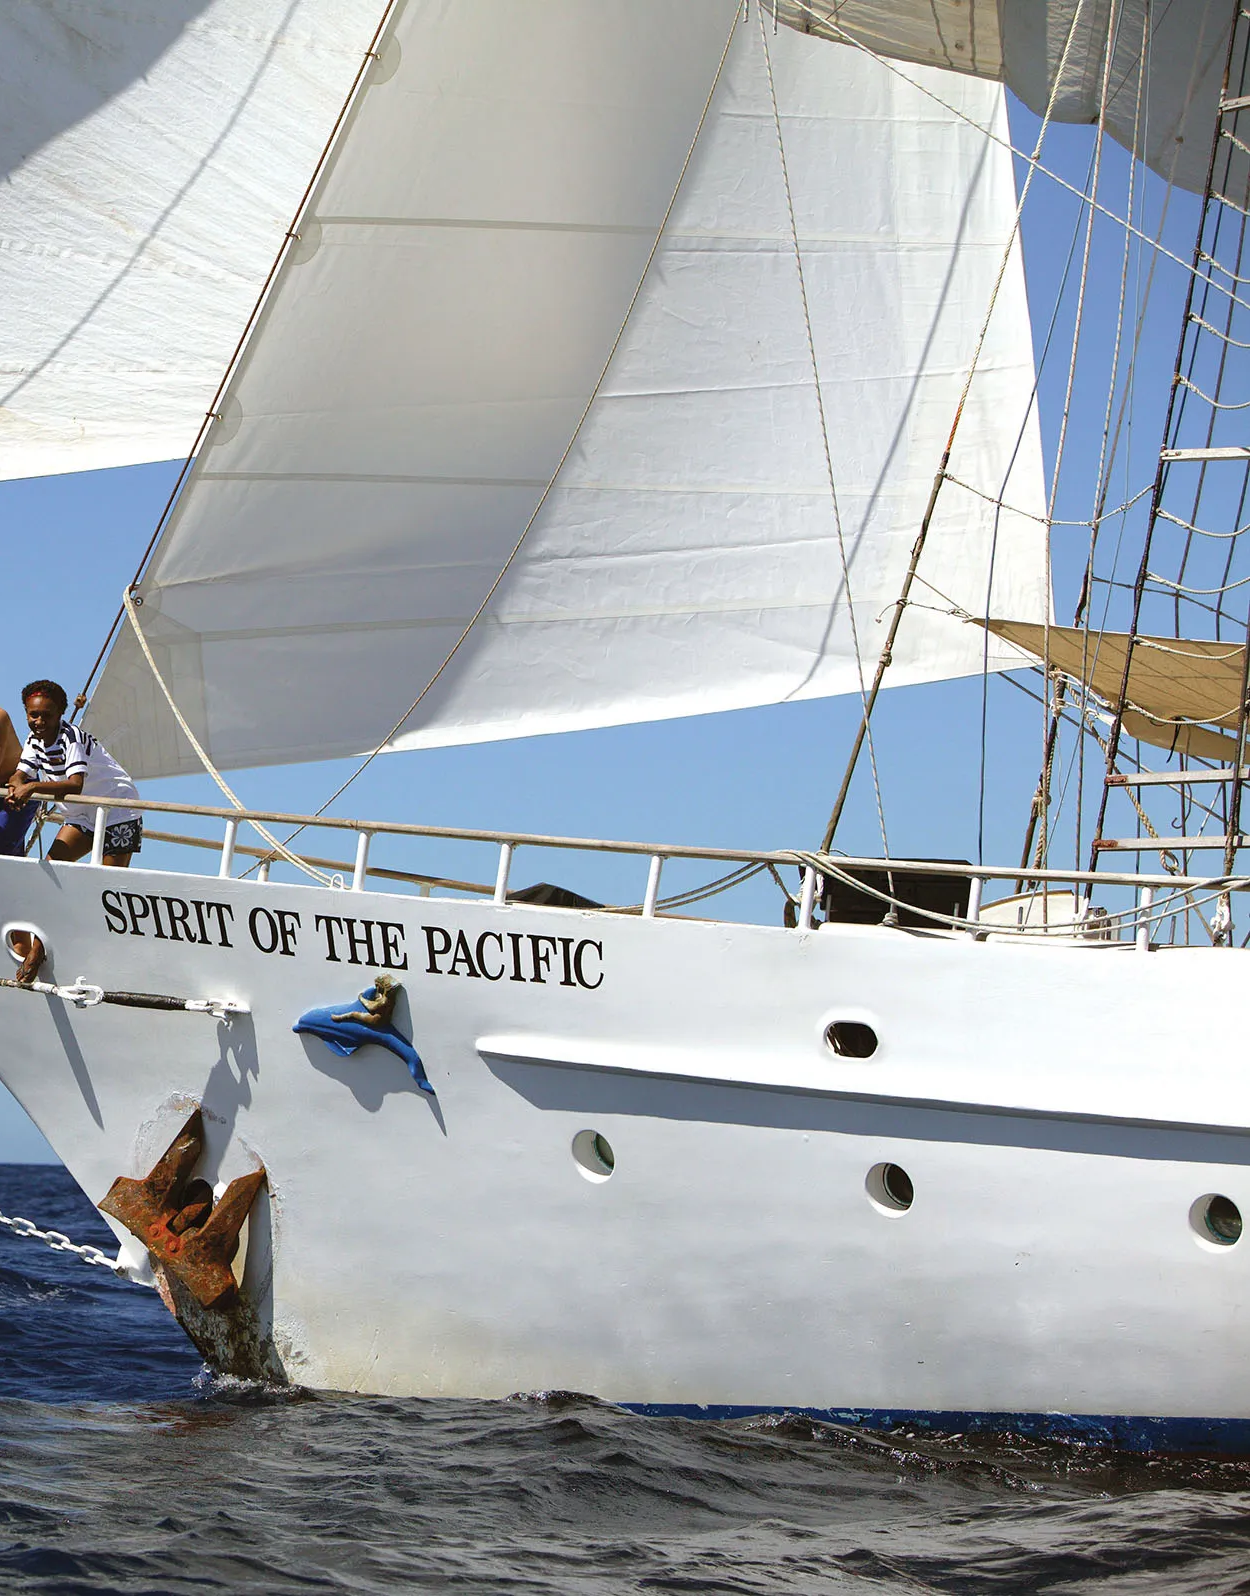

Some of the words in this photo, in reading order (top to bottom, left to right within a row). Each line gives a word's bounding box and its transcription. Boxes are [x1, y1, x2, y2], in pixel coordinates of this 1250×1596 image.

[100, 888, 235, 949] SPIRIT
[248, 906, 303, 958] OF
[313, 913, 410, 972] THE
[420, 924, 606, 991] PACIFIC
